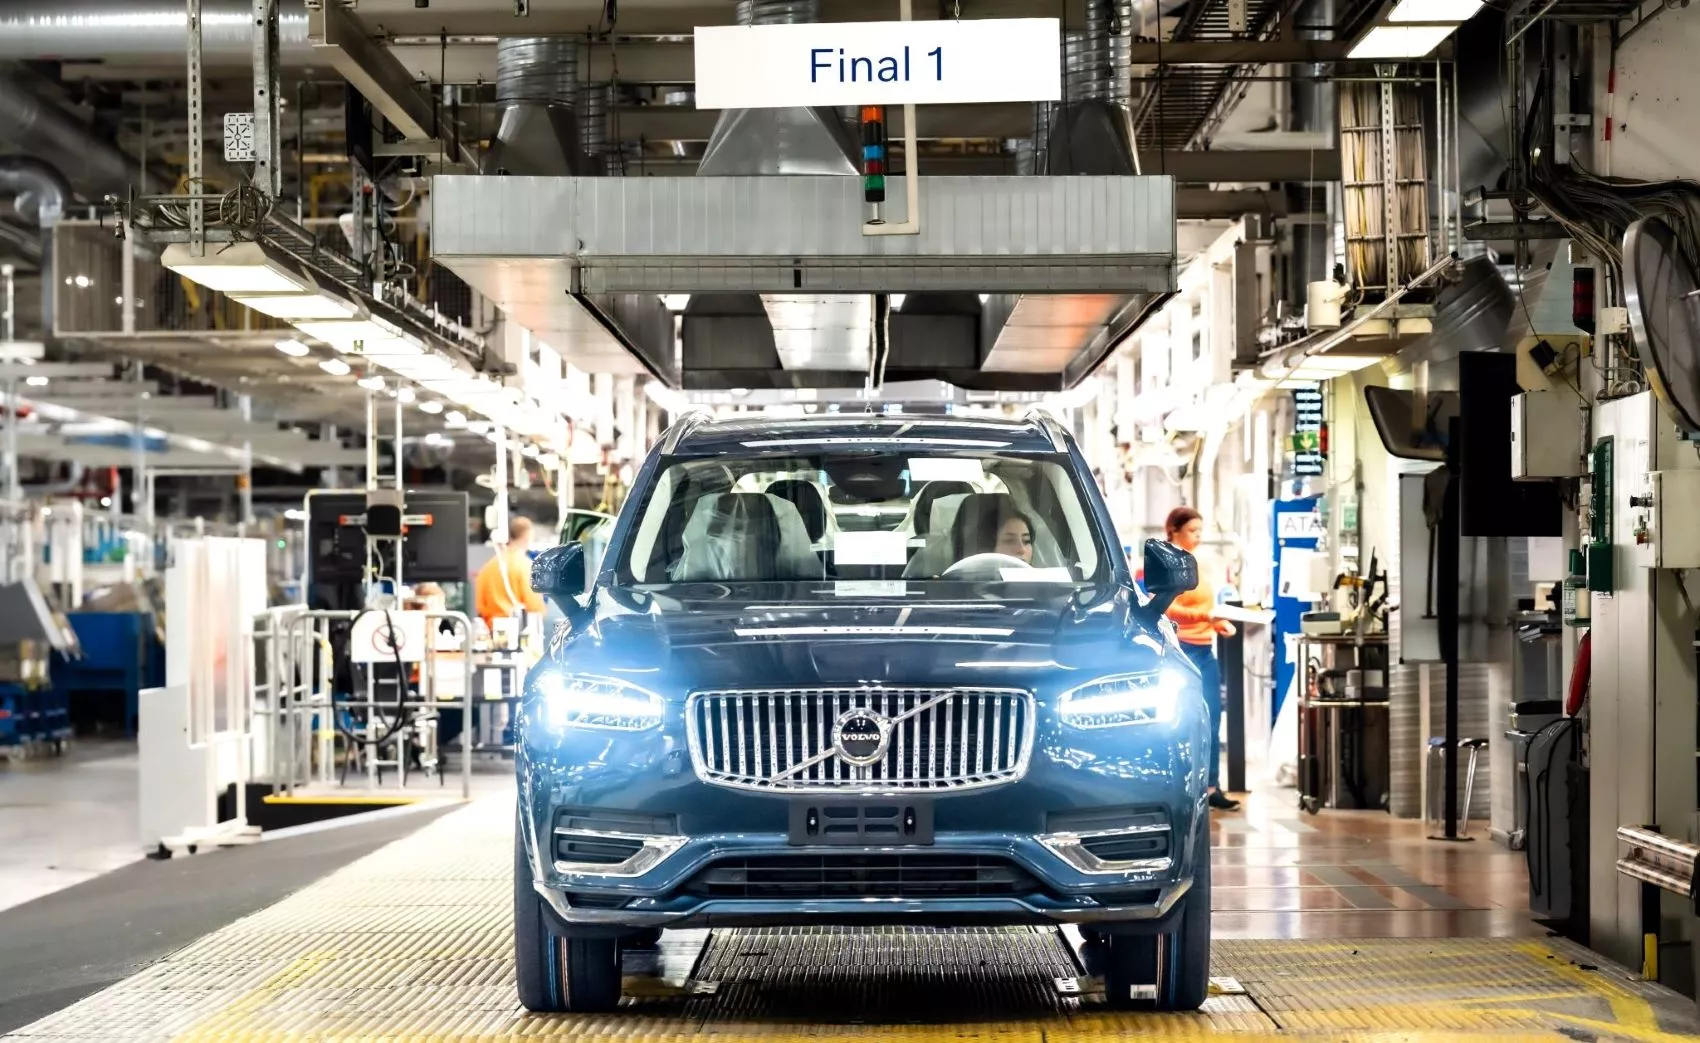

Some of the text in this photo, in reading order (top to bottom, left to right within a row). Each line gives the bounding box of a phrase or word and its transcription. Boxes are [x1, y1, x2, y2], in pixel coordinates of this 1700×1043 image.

[811, 45, 942, 83] Final 1
[841, 733, 880, 741] VOLVO
